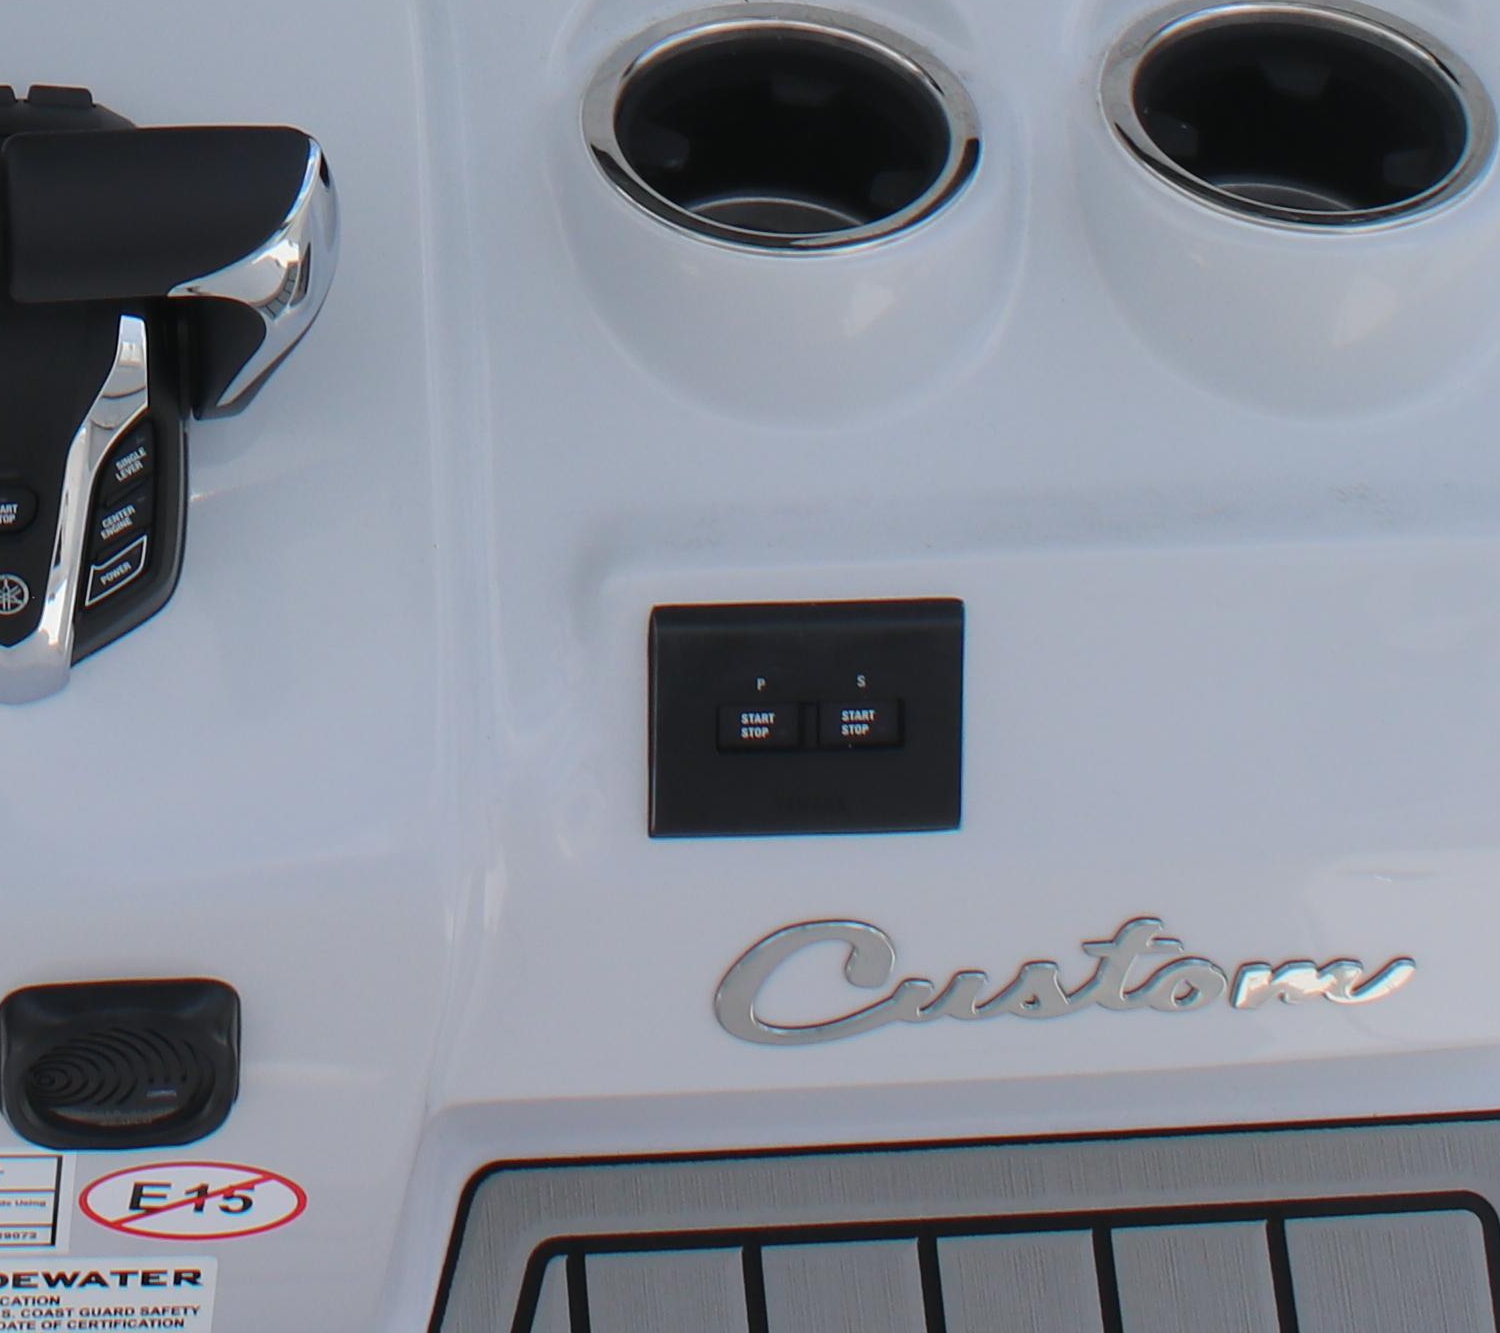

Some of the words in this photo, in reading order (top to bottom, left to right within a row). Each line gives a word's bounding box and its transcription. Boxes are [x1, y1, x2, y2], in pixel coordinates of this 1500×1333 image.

[115, 446, 147, 471] SINGLE
[115, 459, 144, 482] LEVER
[102, 504, 136, 529] CENTER
[100, 517, 134, 540] ENGINE
[100, 561, 132, 585] POWER
[756, 678, 766, 691] P
[856, 675, 866, 688] S
[741, 712, 775, 725] START
[841, 709, 875, 722] START
[741, 726, 769, 738] STOP
[841, 723, 869, 736] STOP
[712, 917, 1416, 1046] Custom
[21, 1307, 75, 1318] COAST
[79, 1307, 135, 1318] GUARD
[139, 1305, 200, 1317] SAFETY
[41, 1319, 62, 1330] OF
[67, 1318, 185, 1329] CERTIFICATION
